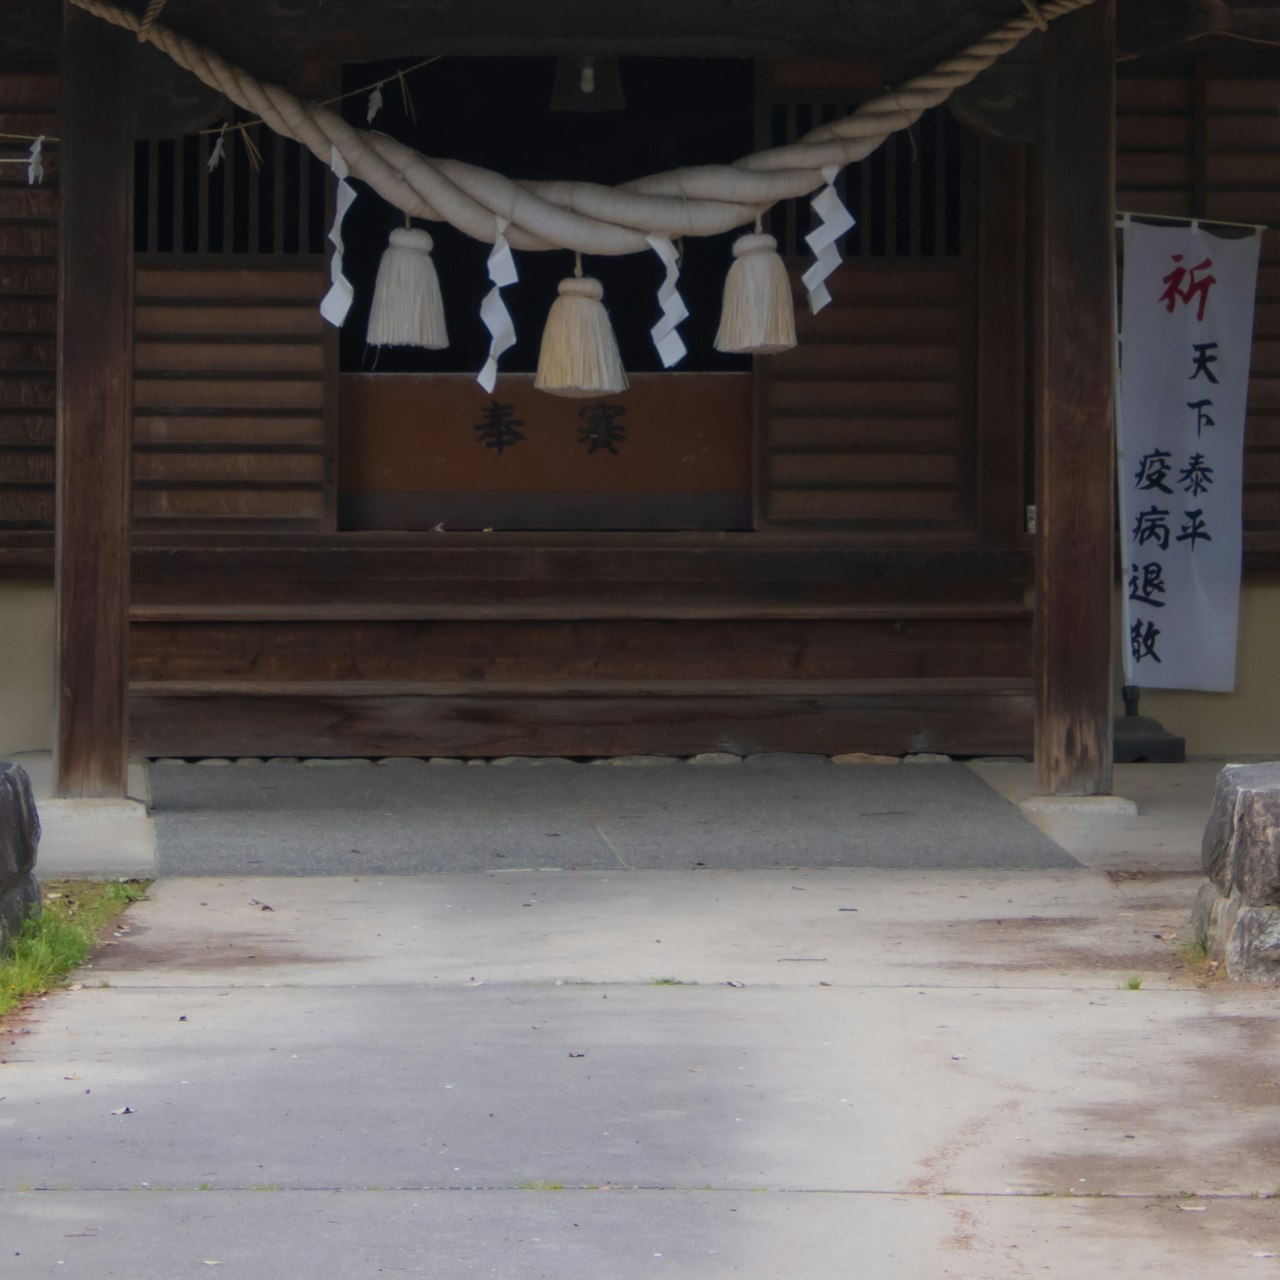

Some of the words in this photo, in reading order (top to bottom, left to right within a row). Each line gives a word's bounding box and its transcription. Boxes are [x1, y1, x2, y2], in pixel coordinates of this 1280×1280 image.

[1157, 253, 1217, 322] 祈
[1175, 342, 1219, 553] 天下泰平
[1128, 449, 1175, 664] 疫病退散
